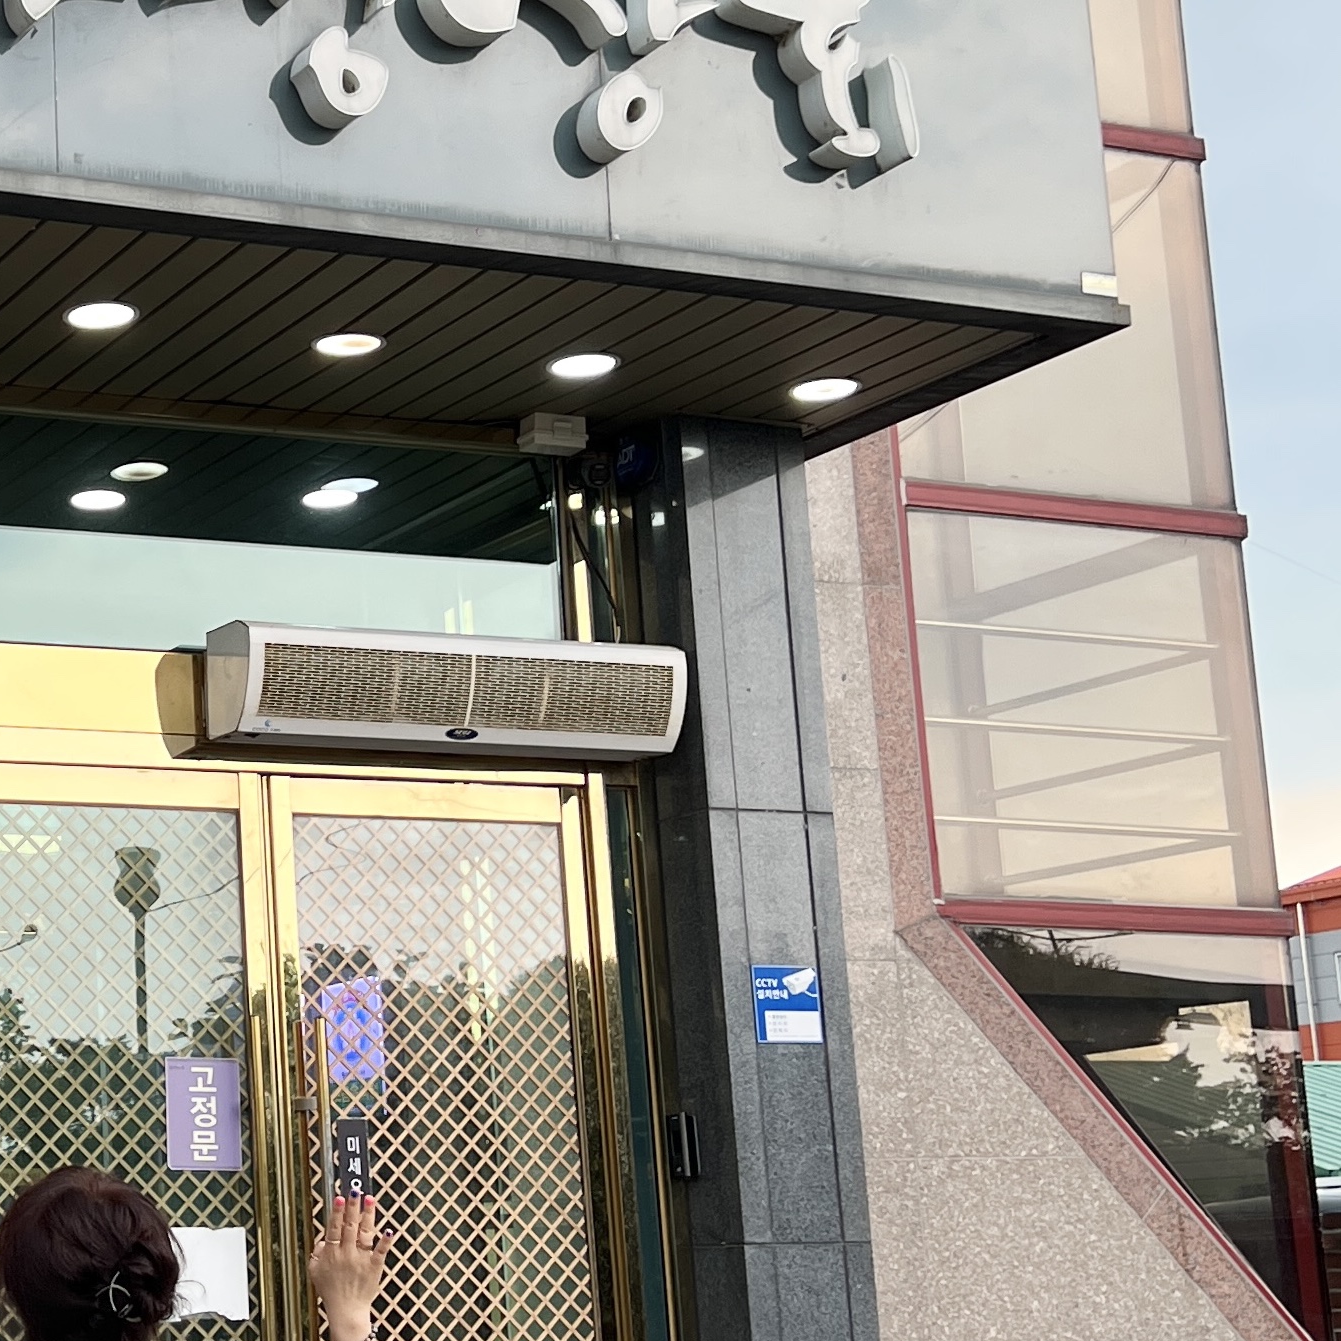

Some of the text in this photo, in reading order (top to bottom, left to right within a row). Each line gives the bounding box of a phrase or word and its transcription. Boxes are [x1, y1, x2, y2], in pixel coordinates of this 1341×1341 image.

[755, 978, 779, 988] CCTV
[756, 989, 790, 1000] 설치안내
[188, 1065, 220, 1162] 고정문
